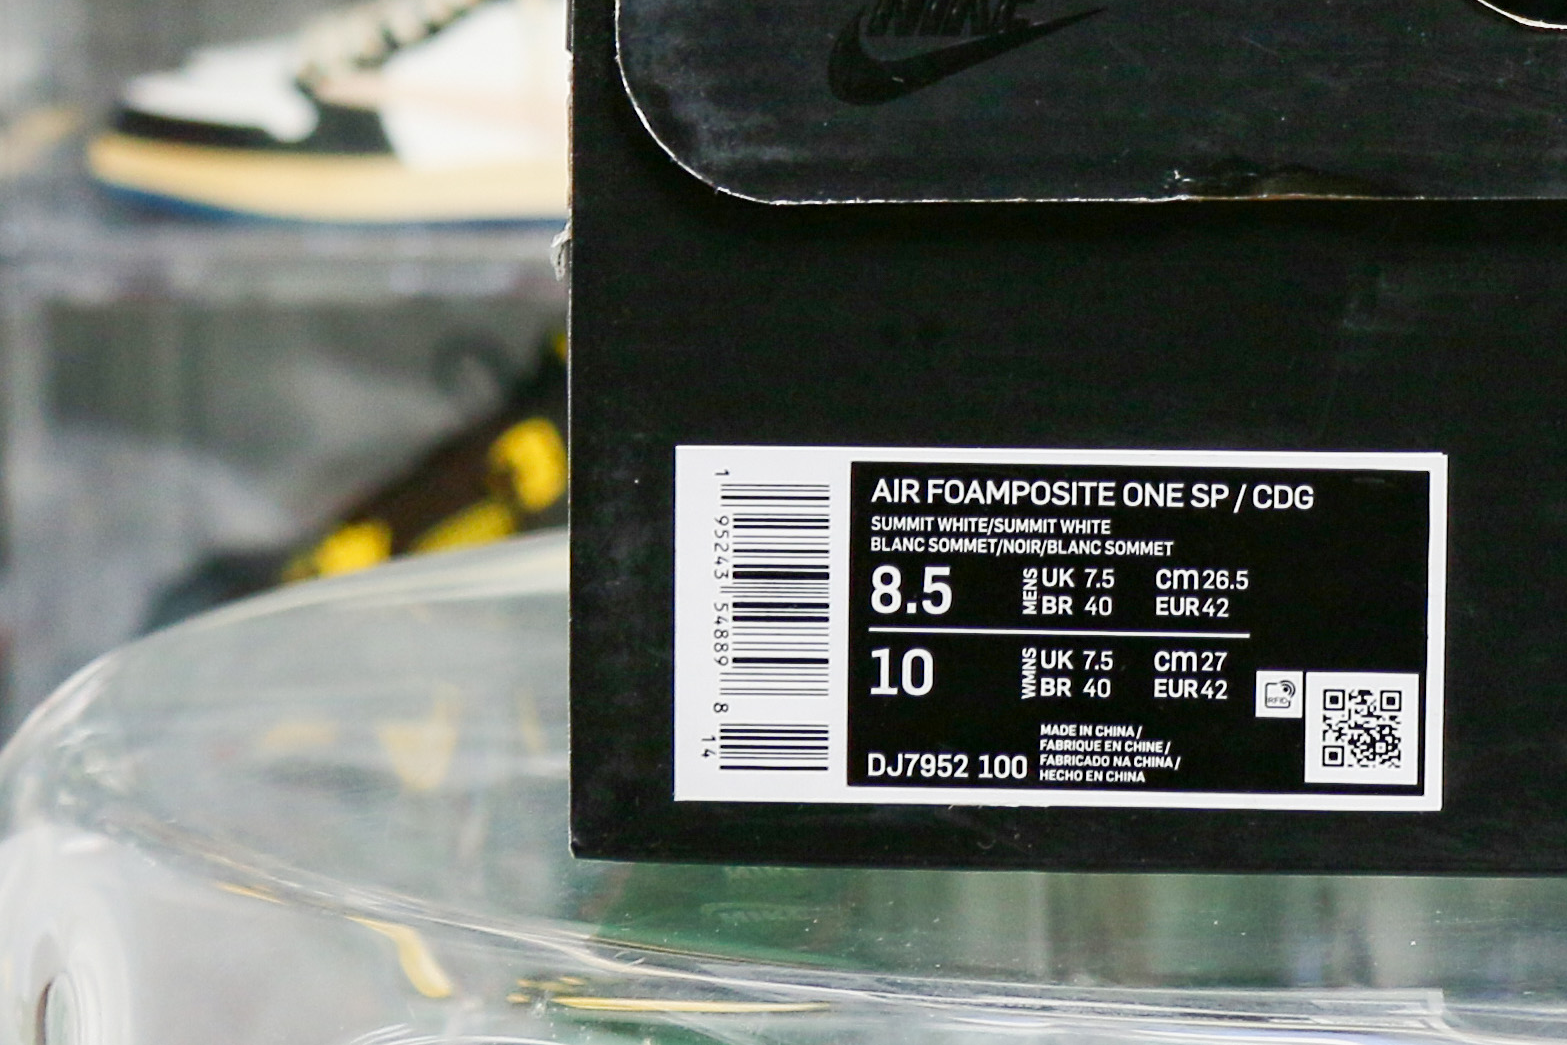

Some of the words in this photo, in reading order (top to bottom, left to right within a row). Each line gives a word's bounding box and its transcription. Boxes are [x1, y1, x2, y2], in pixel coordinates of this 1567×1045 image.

[870, 477, 921, 504] AIR
[927, 479, 1116, 507] FOAMPOSITE
[1122, 481, 1185, 508] ONE
[1190, 483, 1230, 509] SP
[1233, 483, 1248, 514] /
[1252, 483, 1314, 510] CDG
[870, 515, 935, 532] SUMMIT
[937, 516, 1058, 536] WHITE/SUMMIT
[1059, 518, 1112, 535] WHITE
[713, 515, 730, 580] 95243
[870, 536, 926, 553] BLANC
[927, 537, 1102, 558] SOMMET/NOIR/BLANC
[1104, 539, 1175, 557] SOMMET
[870, 564, 953, 615] 8.5
[1022, 567, 1038, 615] MENS
[1041, 567, 1075, 588] UK
[1084, 568, 1115, 589] 7.5
[1155, 568, 1199, 591] cm
[1202, 569, 1249, 590] 26.5
[1041, 595, 1073, 616] BR
[1084, 595, 1113, 616] 40
[1155, 596, 1200, 617] EUR
[1201, 597, 1230, 618] 42
[713, 602, 730, 667] 54889
[870, 647, 934, 697] 10
[1040, 649, 1074, 670] UK
[1082, 650, 1114, 671] 7.5
[1153, 650, 1198, 673] cm
[1200, 651, 1228, 672] 27
[1020, 647, 1037, 700] WMNS
[1040, 677, 1072, 698] BR
[1082, 677, 1111, 699] 40
[1153, 678, 1199, 699] EUR
[1200, 679, 1228, 700] 42
[712, 702, 729, 714] 8
[1040, 723, 1078, 737] MADE
[1078, 724, 1093, 737] IN
[1094, 724, 1135, 738] CHINA
[1135, 725, 1143, 740] /
[1039, 738, 1102, 753] FABRIQUE
[1104, 739, 1122, 752] EN
[1124, 740, 1164, 754] CHINE
[1164, 741, 1172, 756] /
[867, 752, 969, 778] DJ7952
[978, 754, 1028, 780] 100
[1039, 753, 1111, 768] FABRICADO
[1112, 755, 1132, 768] NA
[1133, 755, 1174, 768] CHINA
[1174, 756, 1182, 771] /
[1039, 768, 1084, 782] HECHO
[1085, 769, 1104, 782] EN
[1105, 770, 1146, 783] CHINA
